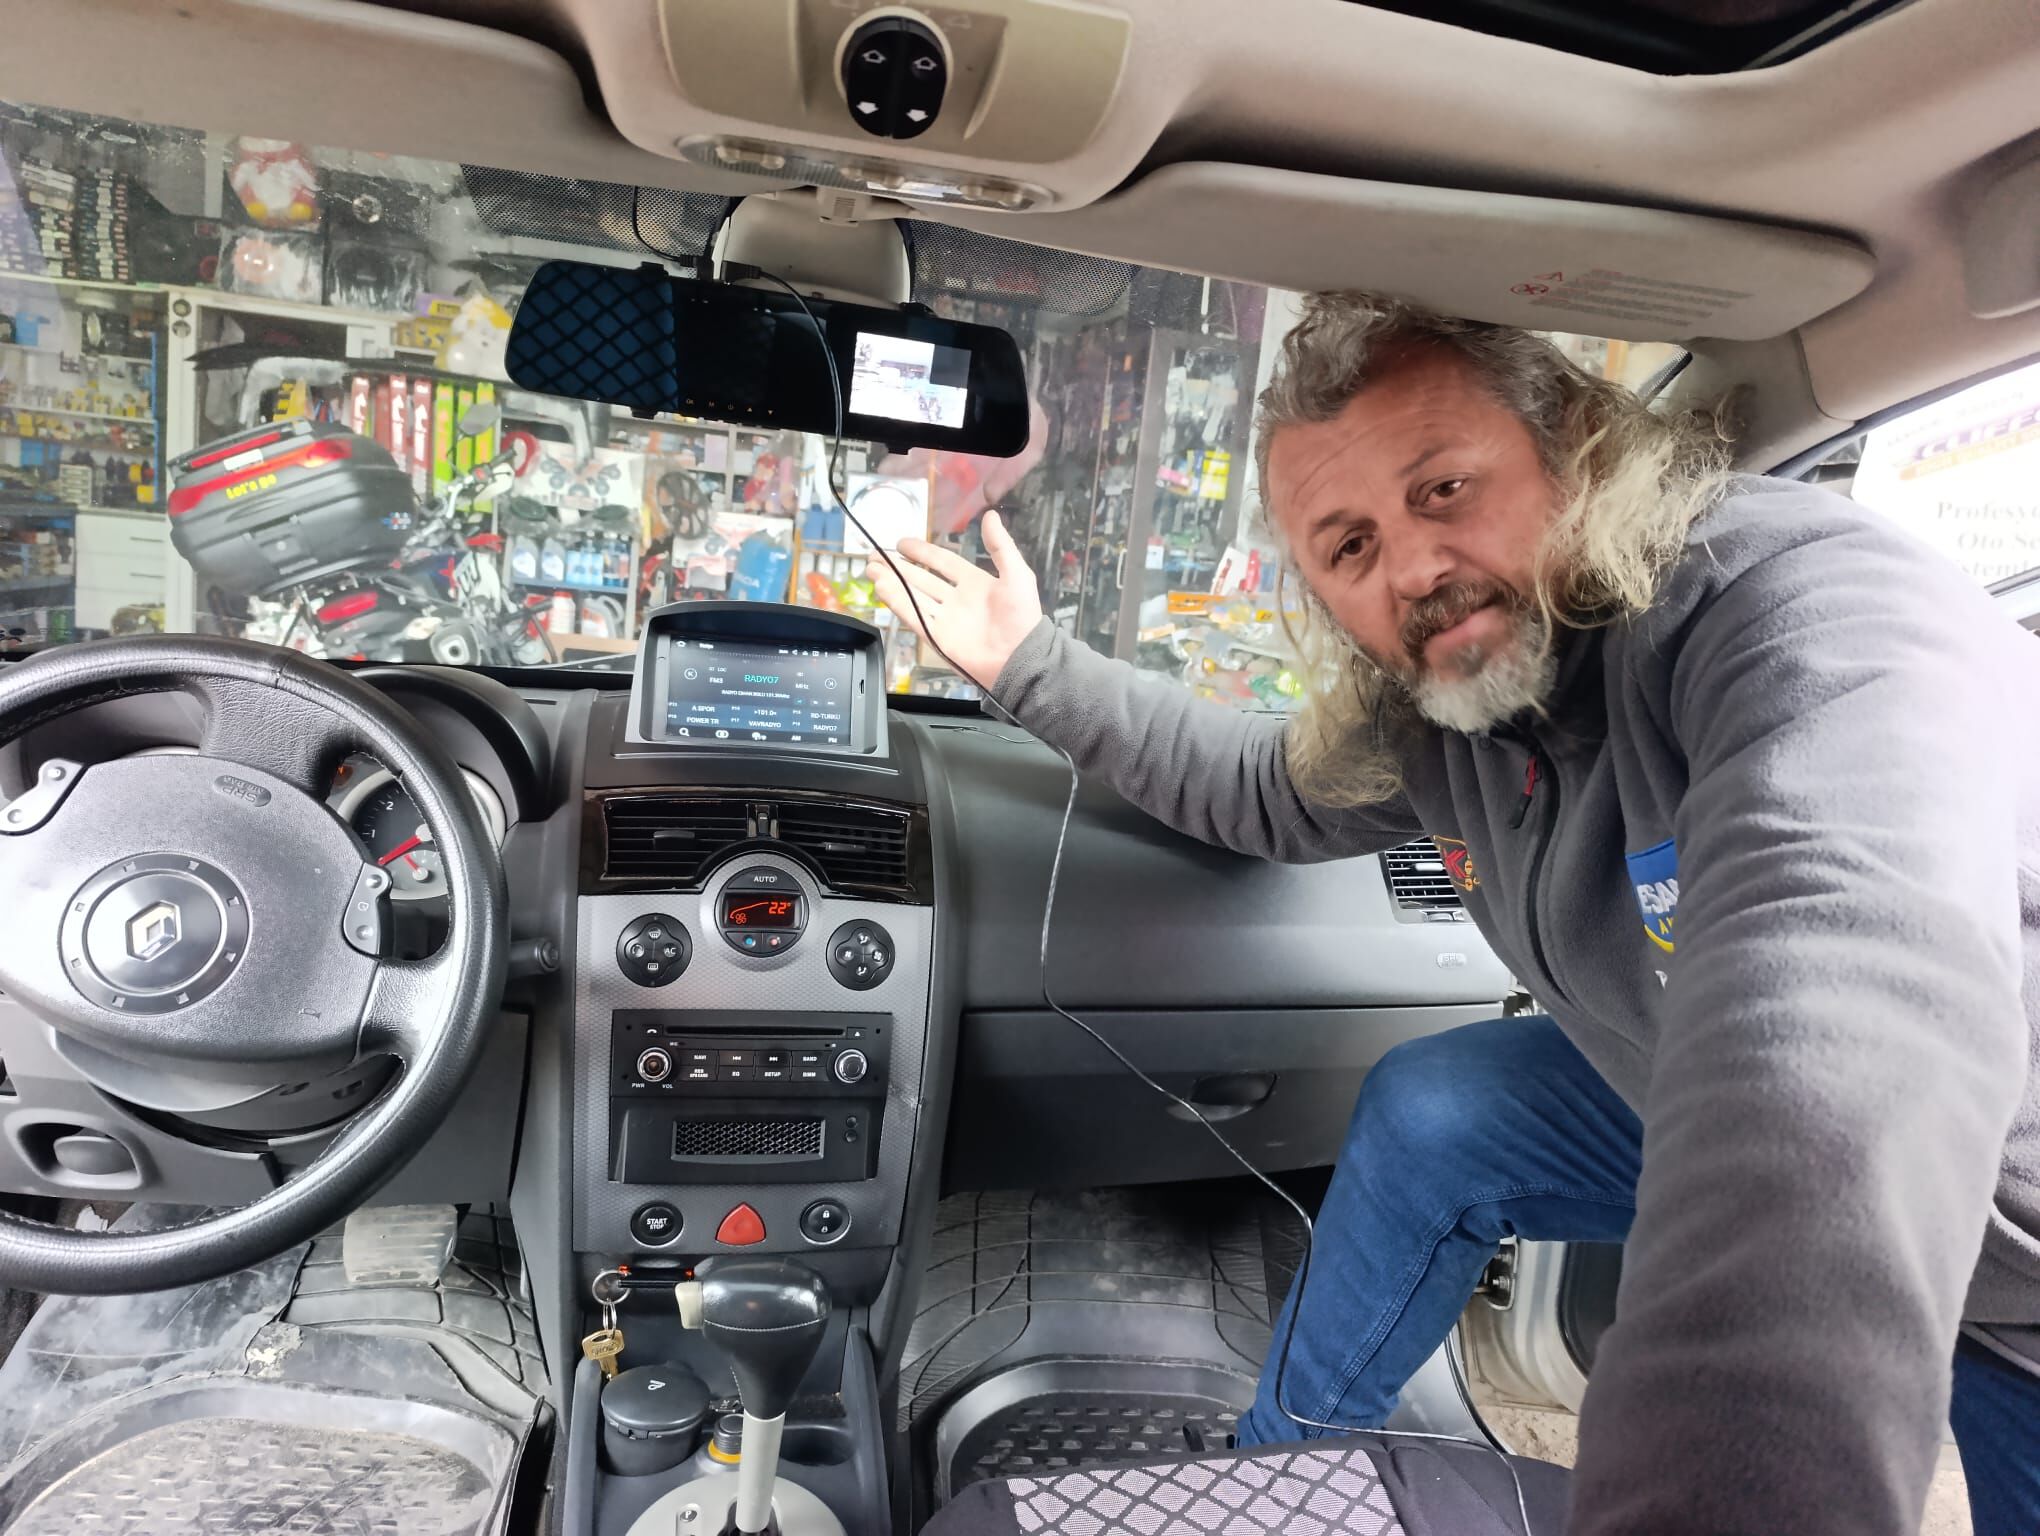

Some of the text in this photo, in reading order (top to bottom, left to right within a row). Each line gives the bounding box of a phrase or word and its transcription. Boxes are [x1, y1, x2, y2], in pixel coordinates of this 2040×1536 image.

[1957, 532, 2004, 550] Oto
[744, 674, 779, 684] RADYO7
[386, 801, 394, 810] 2
[753, 875, 775, 883] AUTO
[664, 947, 676, 955] AC
[646, 1217, 668, 1226] START
[685, 1510, 692, 1519] P
